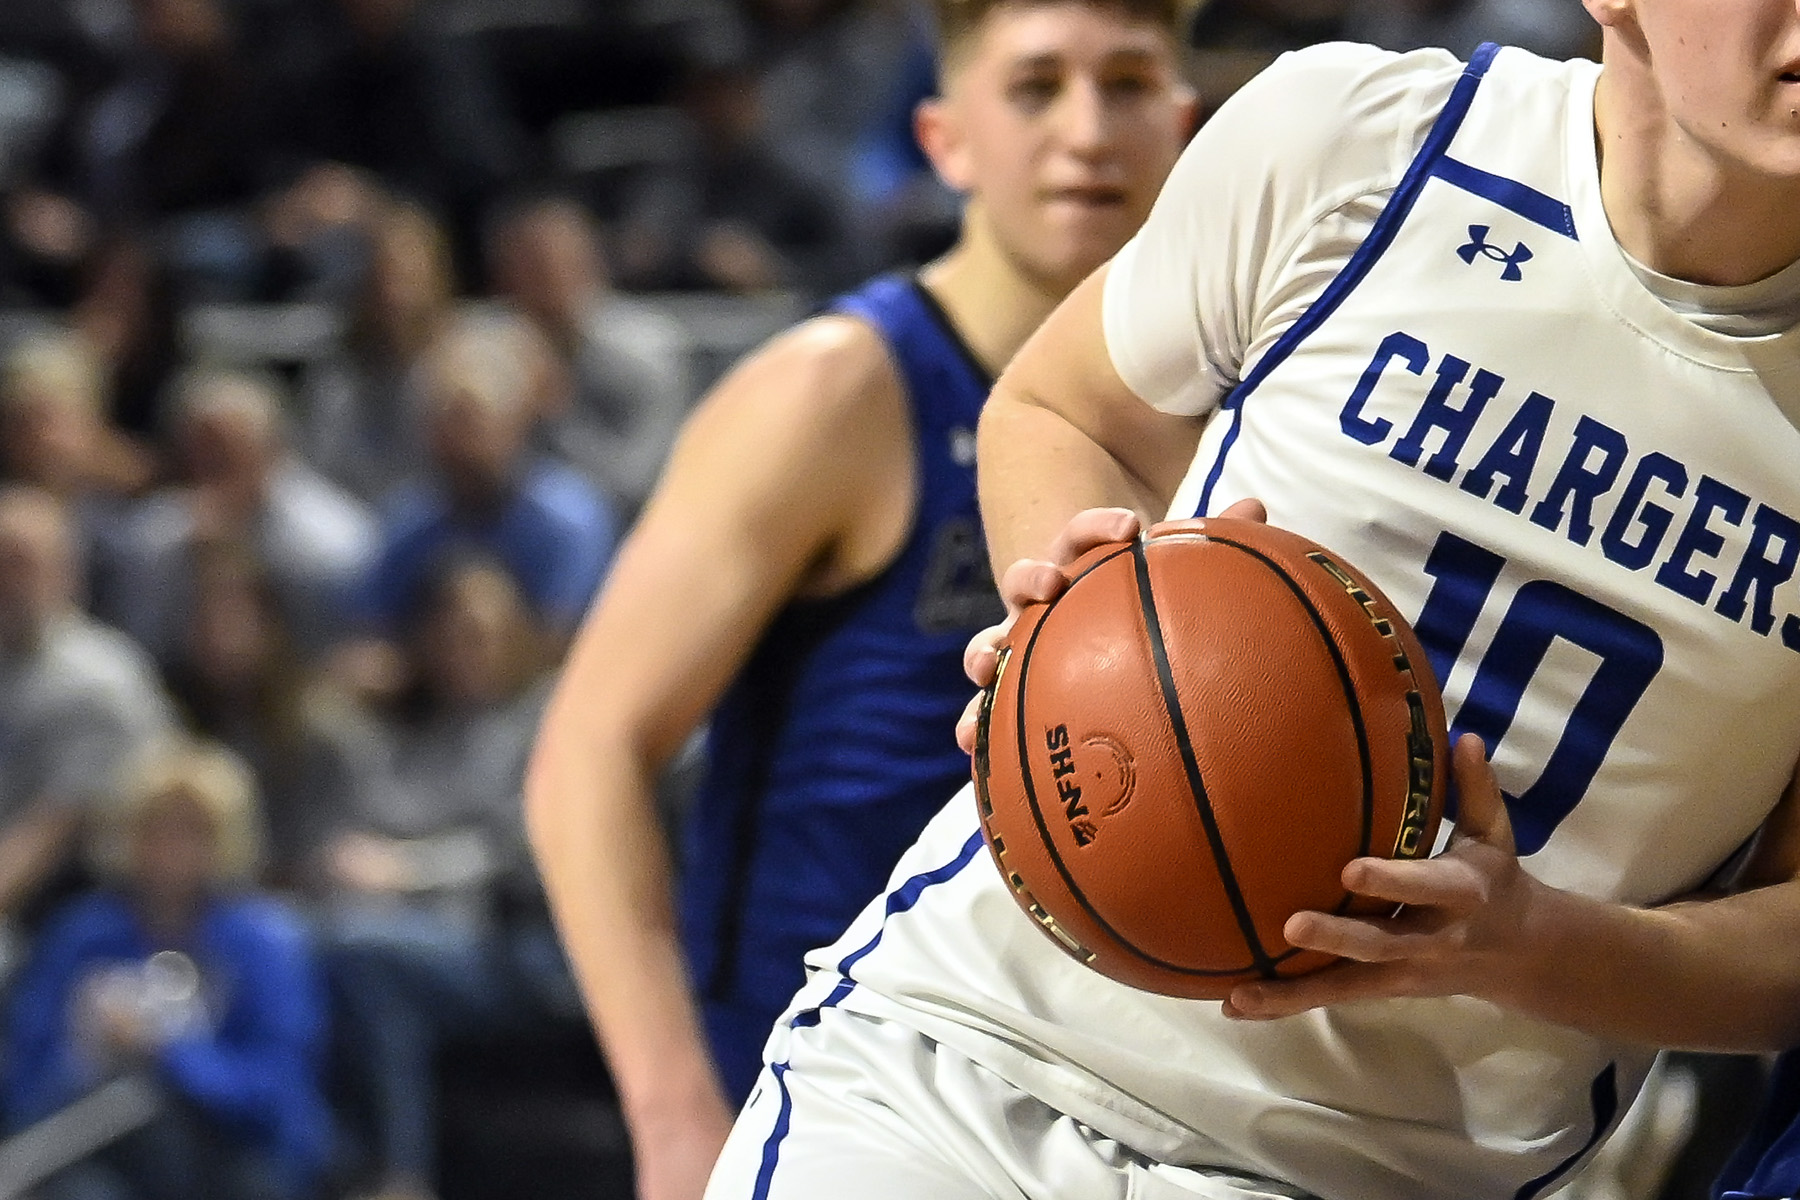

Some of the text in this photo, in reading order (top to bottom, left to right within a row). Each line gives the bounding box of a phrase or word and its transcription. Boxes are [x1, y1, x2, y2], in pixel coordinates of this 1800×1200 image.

[1412, 530, 1665, 857] 10
[1045, 723, 1090, 822] NFHS
[1400, 755, 1433, 855] PRO
